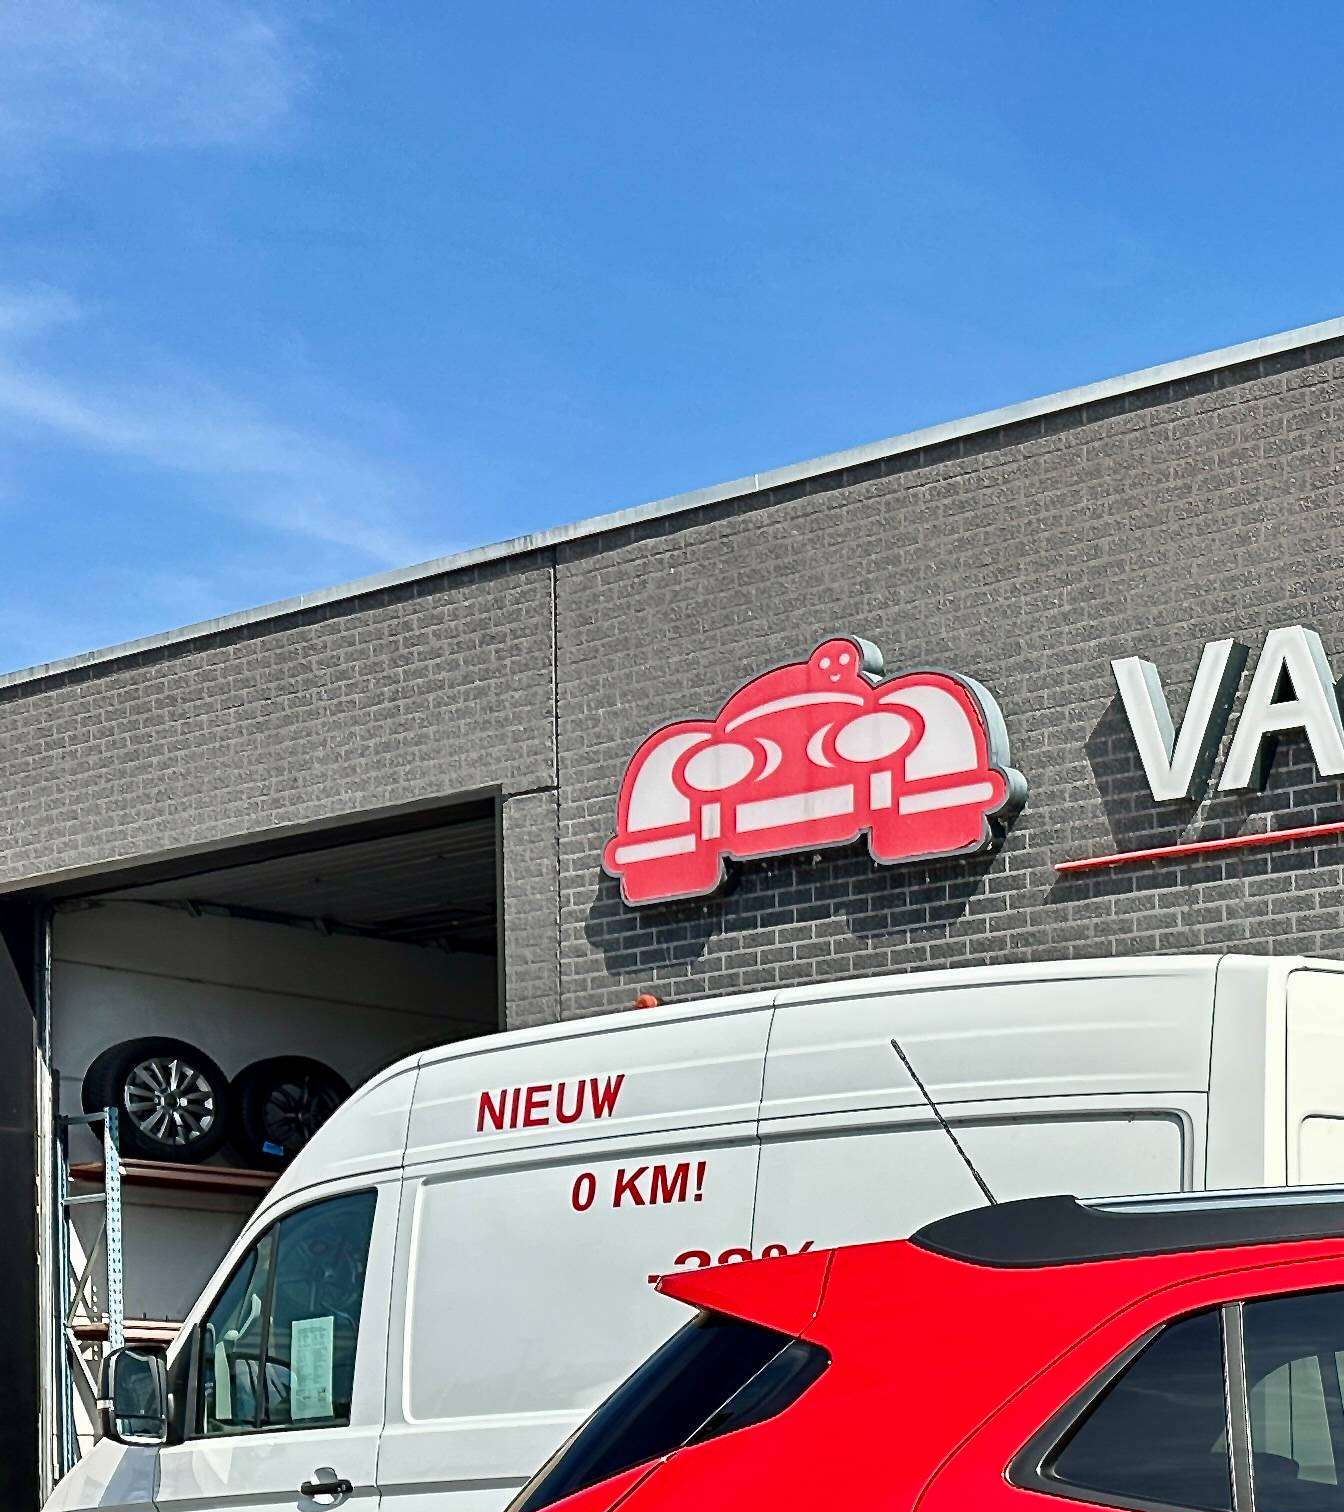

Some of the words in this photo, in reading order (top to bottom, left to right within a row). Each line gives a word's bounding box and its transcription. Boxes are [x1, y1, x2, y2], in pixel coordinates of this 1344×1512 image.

[476, 1074, 625, 1132] NIEUW
[572, 1172, 596, 1211] 0
[612, 1161, 706, 1207] KM!
